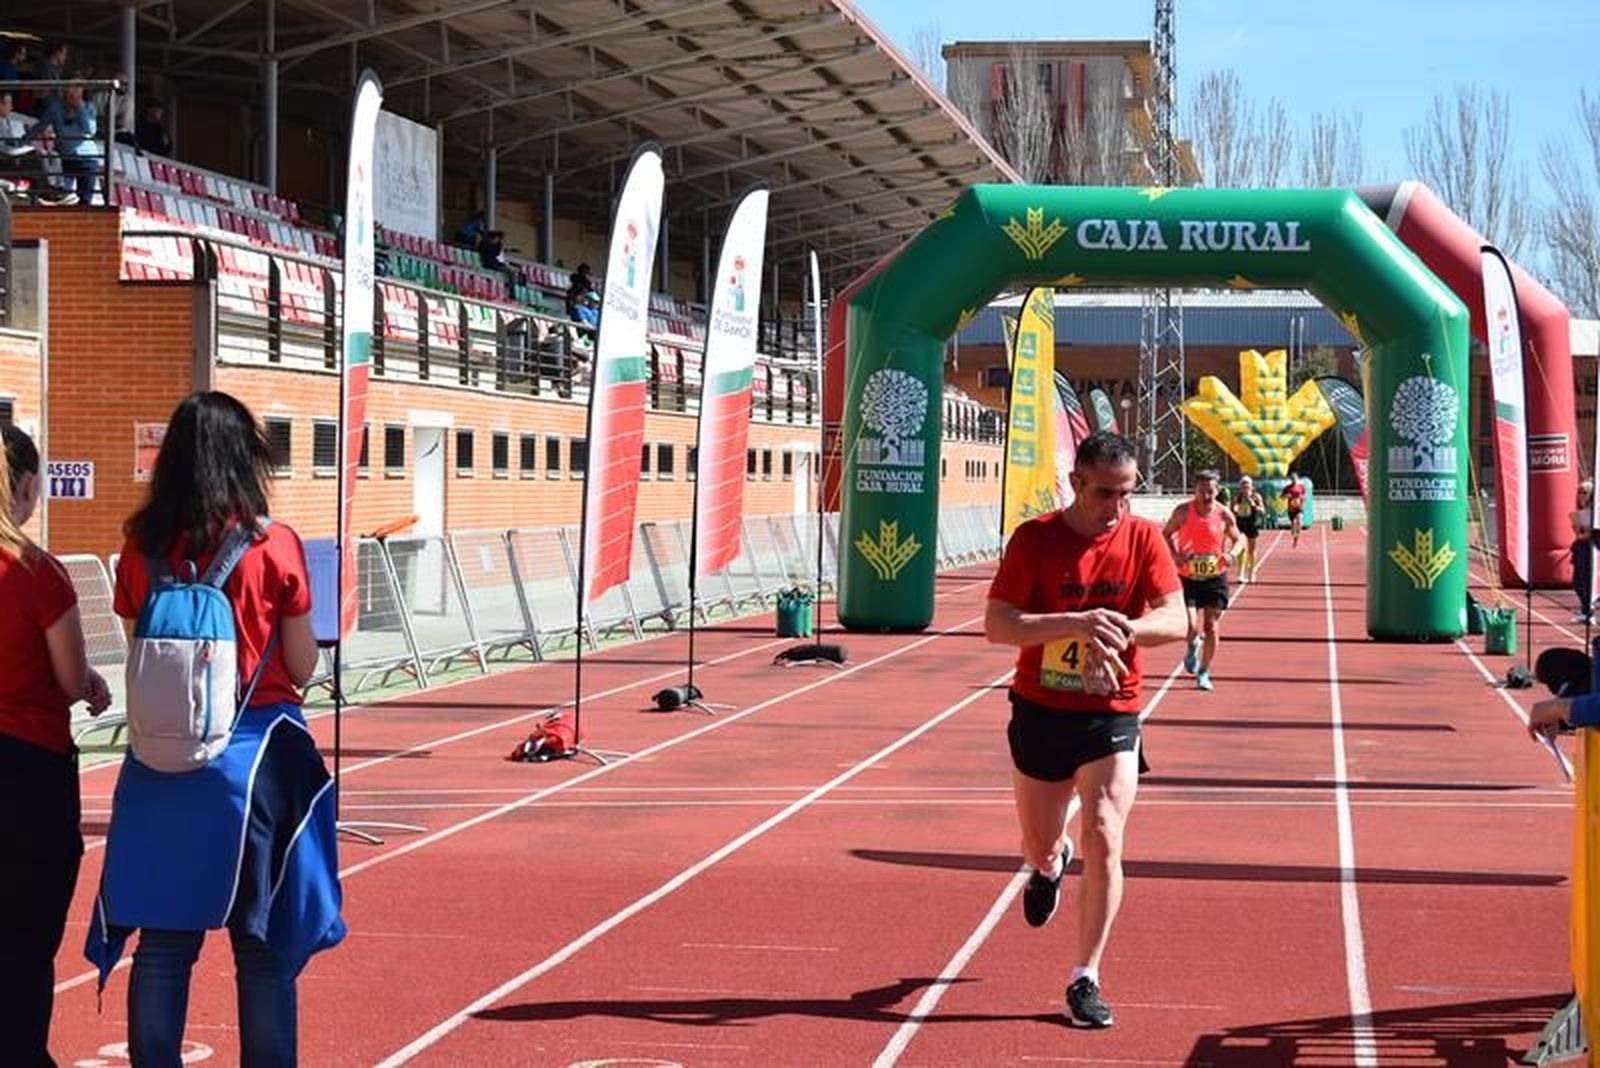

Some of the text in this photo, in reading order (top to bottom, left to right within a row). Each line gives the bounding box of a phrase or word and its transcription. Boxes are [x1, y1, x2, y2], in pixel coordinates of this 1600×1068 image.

[1077, 219, 1311, 251] CAJA RURAL
[1530, 454, 1568, 466] MORA
[48, 463, 90, 476] ASEOS
[856, 481, 924, 493] CAJA RURAL
[1389, 489, 1457, 501] CAJA RURAL
[1193, 561, 1216, 575] 105
